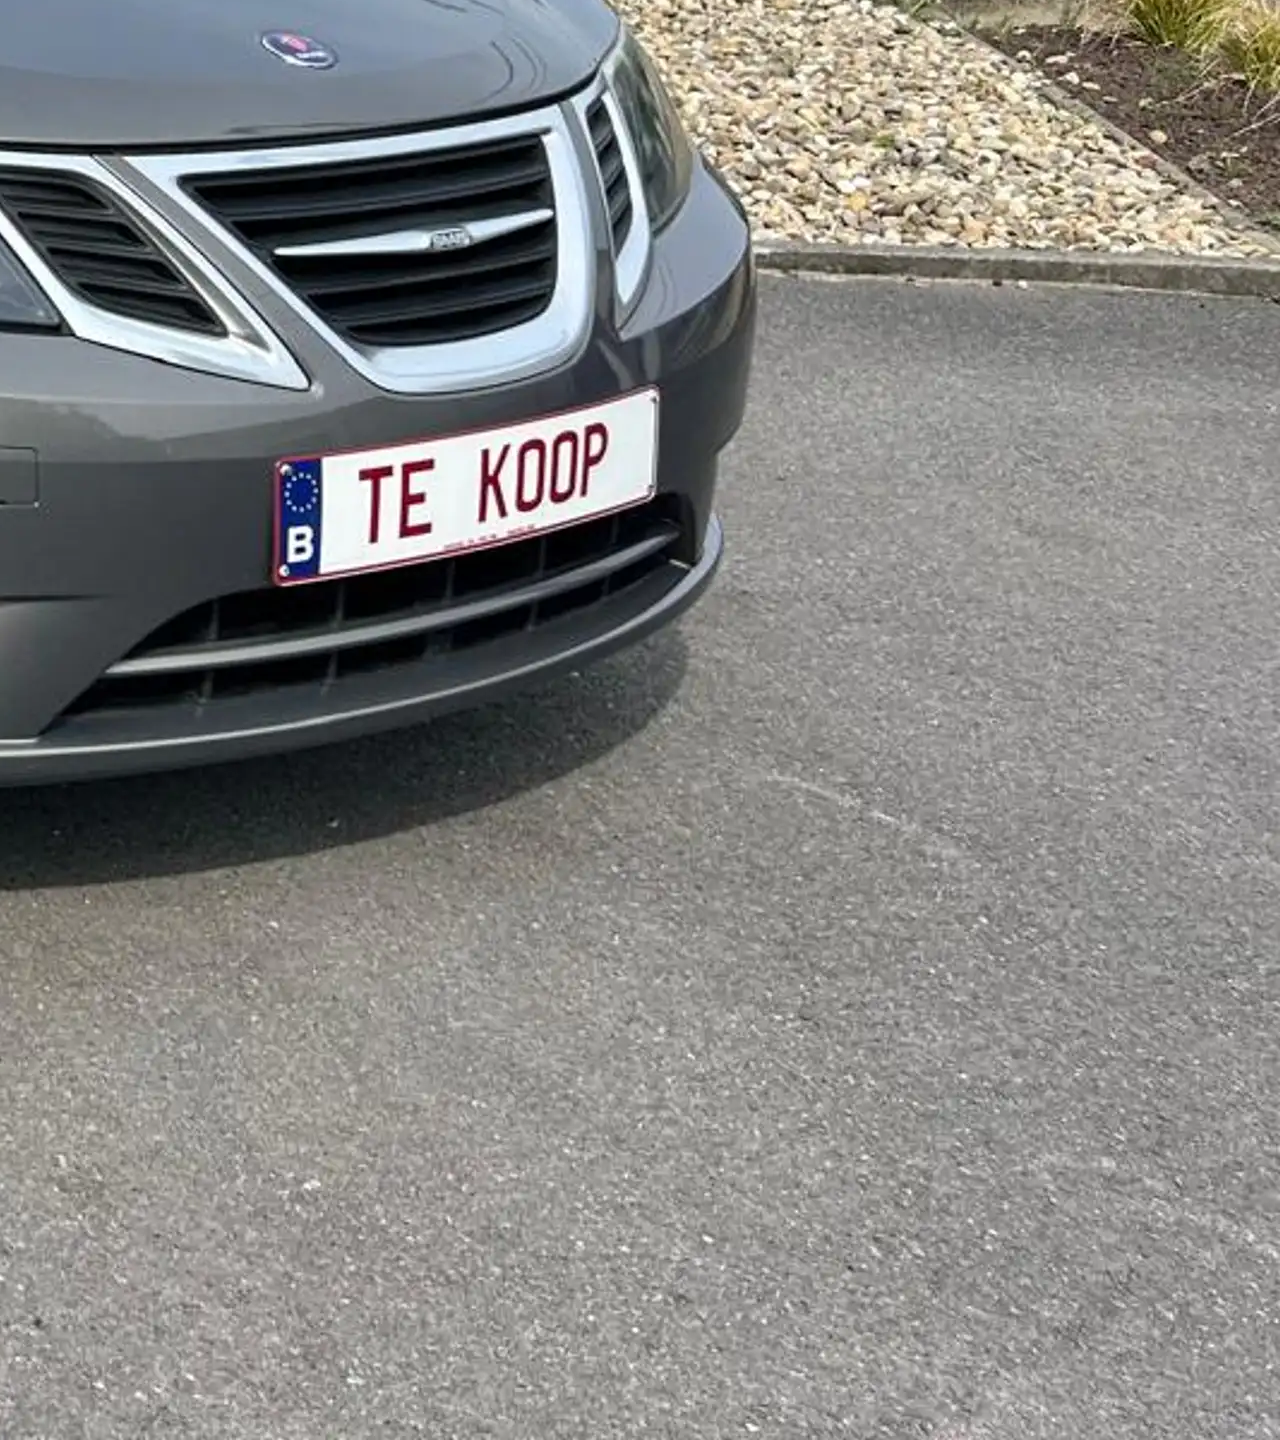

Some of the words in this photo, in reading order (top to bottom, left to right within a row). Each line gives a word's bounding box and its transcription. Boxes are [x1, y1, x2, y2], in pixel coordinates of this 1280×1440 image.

[358, 458, 436, 544] TE
[477, 421, 609, 524] KOOP
[286, 525, 315, 564] B
